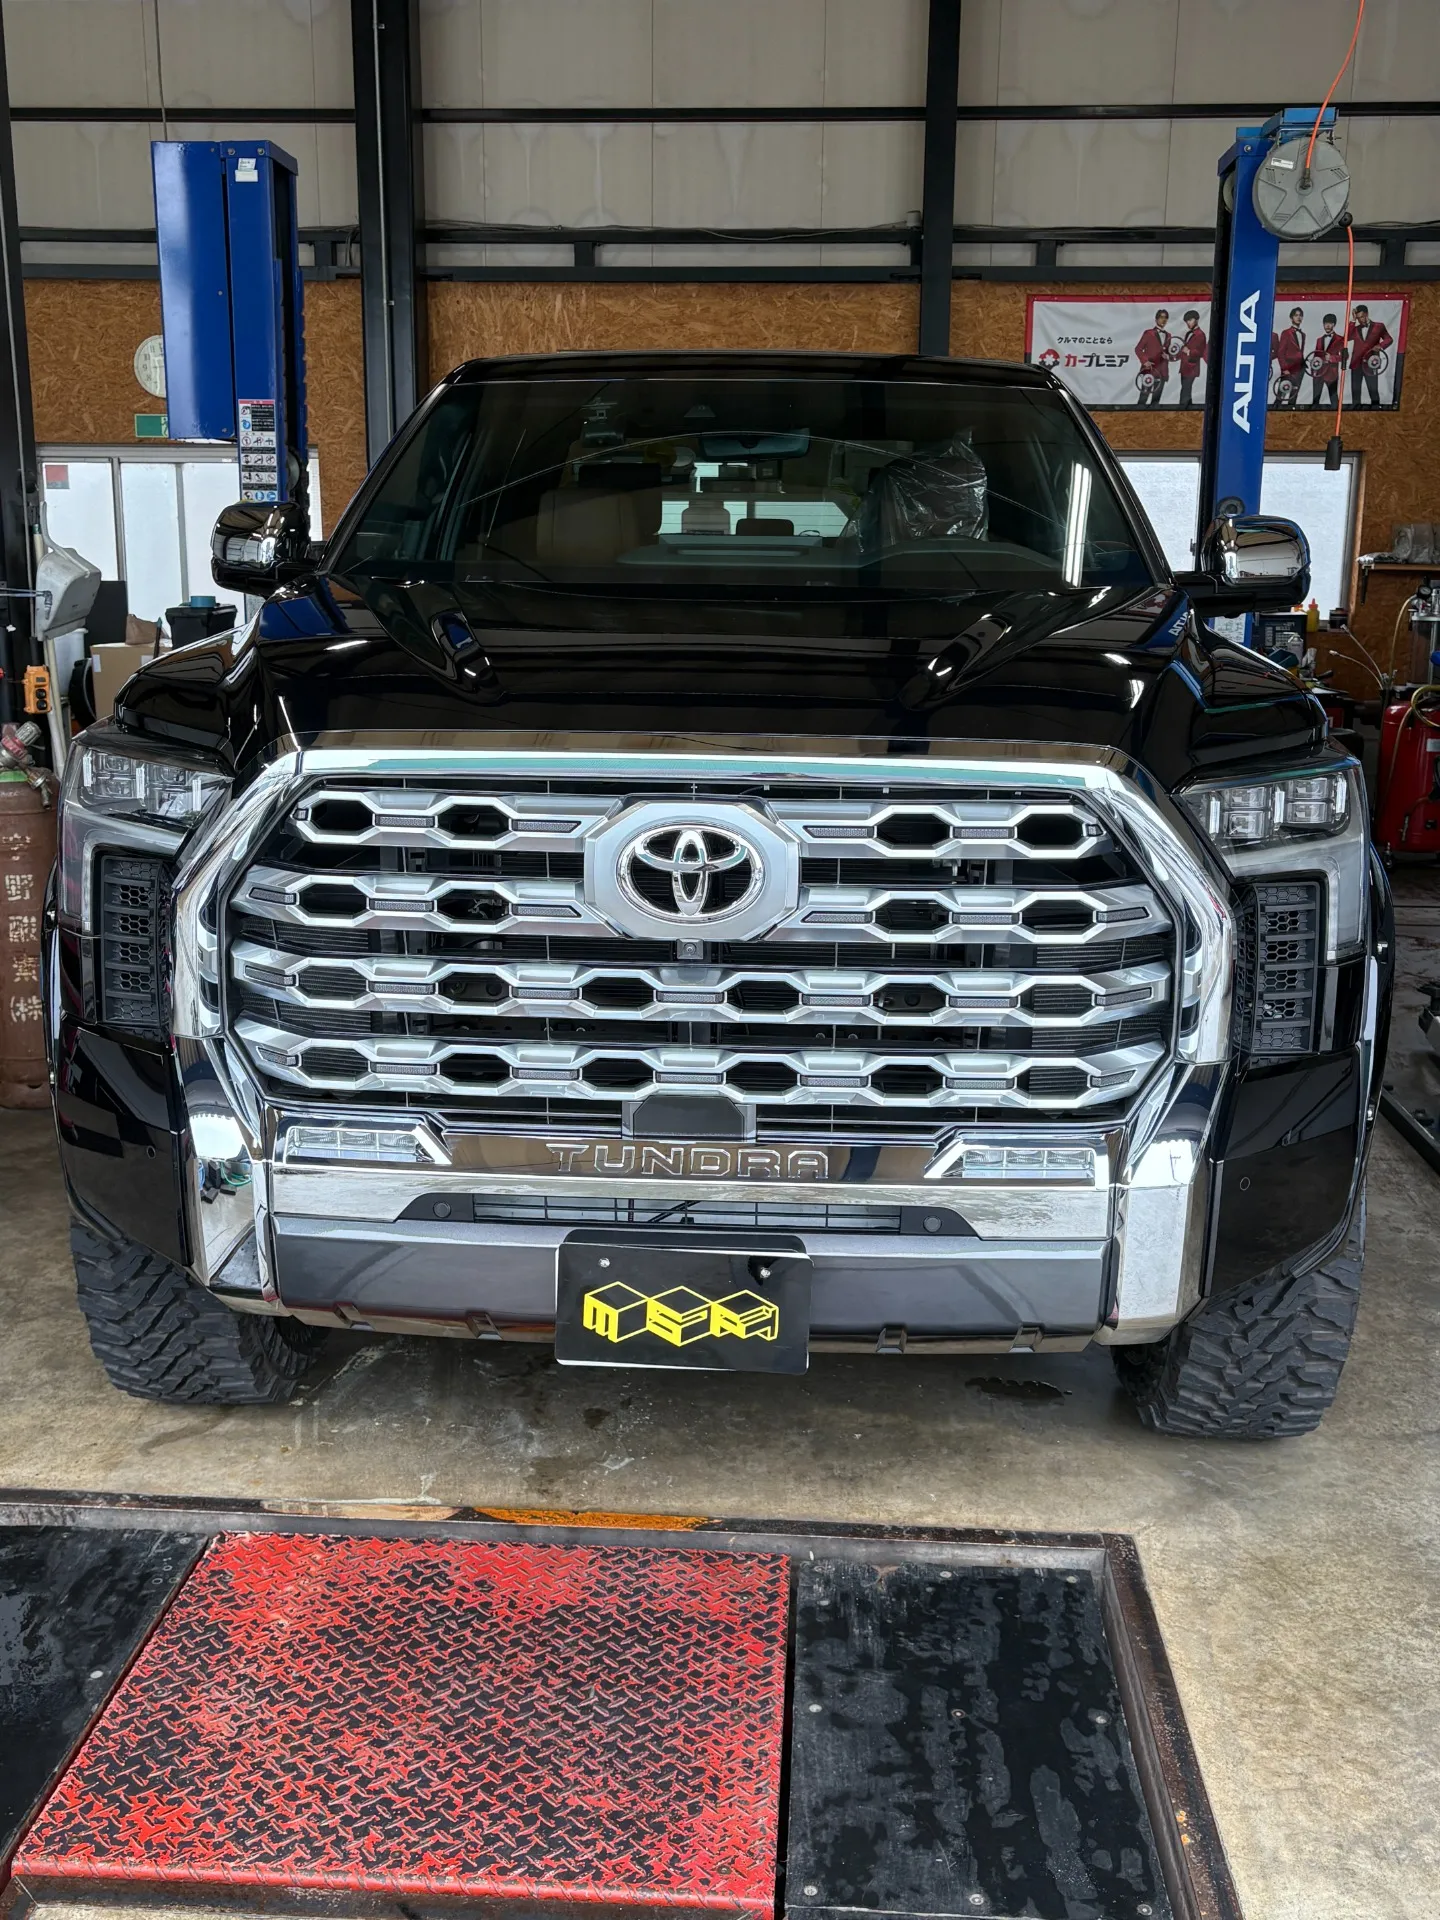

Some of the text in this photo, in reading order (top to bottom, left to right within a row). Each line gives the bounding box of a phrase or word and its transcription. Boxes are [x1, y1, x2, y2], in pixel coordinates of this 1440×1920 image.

[1057, 336, 1113, 345] クルマのことなら
[1064, 353, 1129, 367] カープレミア
[1232, 290, 1260, 434] ALTIA
[546, 1143, 829, 1179] TUNDRA
